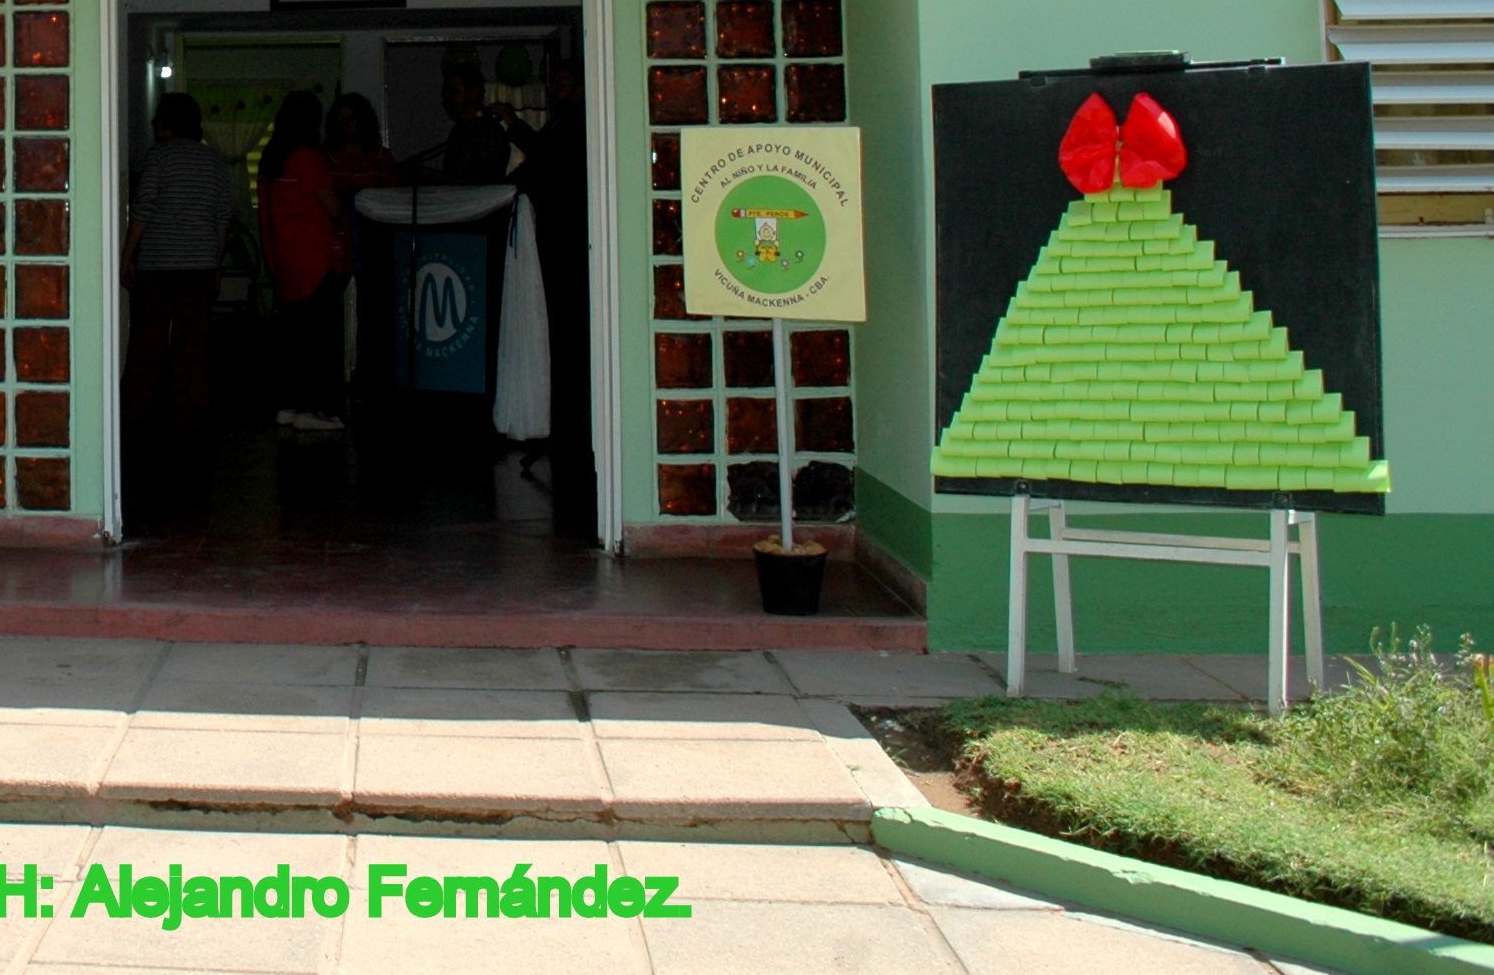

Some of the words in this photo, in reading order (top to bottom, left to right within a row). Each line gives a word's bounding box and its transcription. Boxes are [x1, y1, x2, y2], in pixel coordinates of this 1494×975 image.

[691, 158, 727, 204] CENTRO
[728, 148, 745, 162] DE
[747, 143, 791, 156] APOYO
[794, 150, 849, 208] MUNICIPAL
[719, 177, 732, 189] AL
[766, 164, 779, 172] LA
[781, 165, 817, 190] FAMILIA
[714, 268, 745, 299] VICUÑA
[746, 294, 804, 308] MACKENNA
